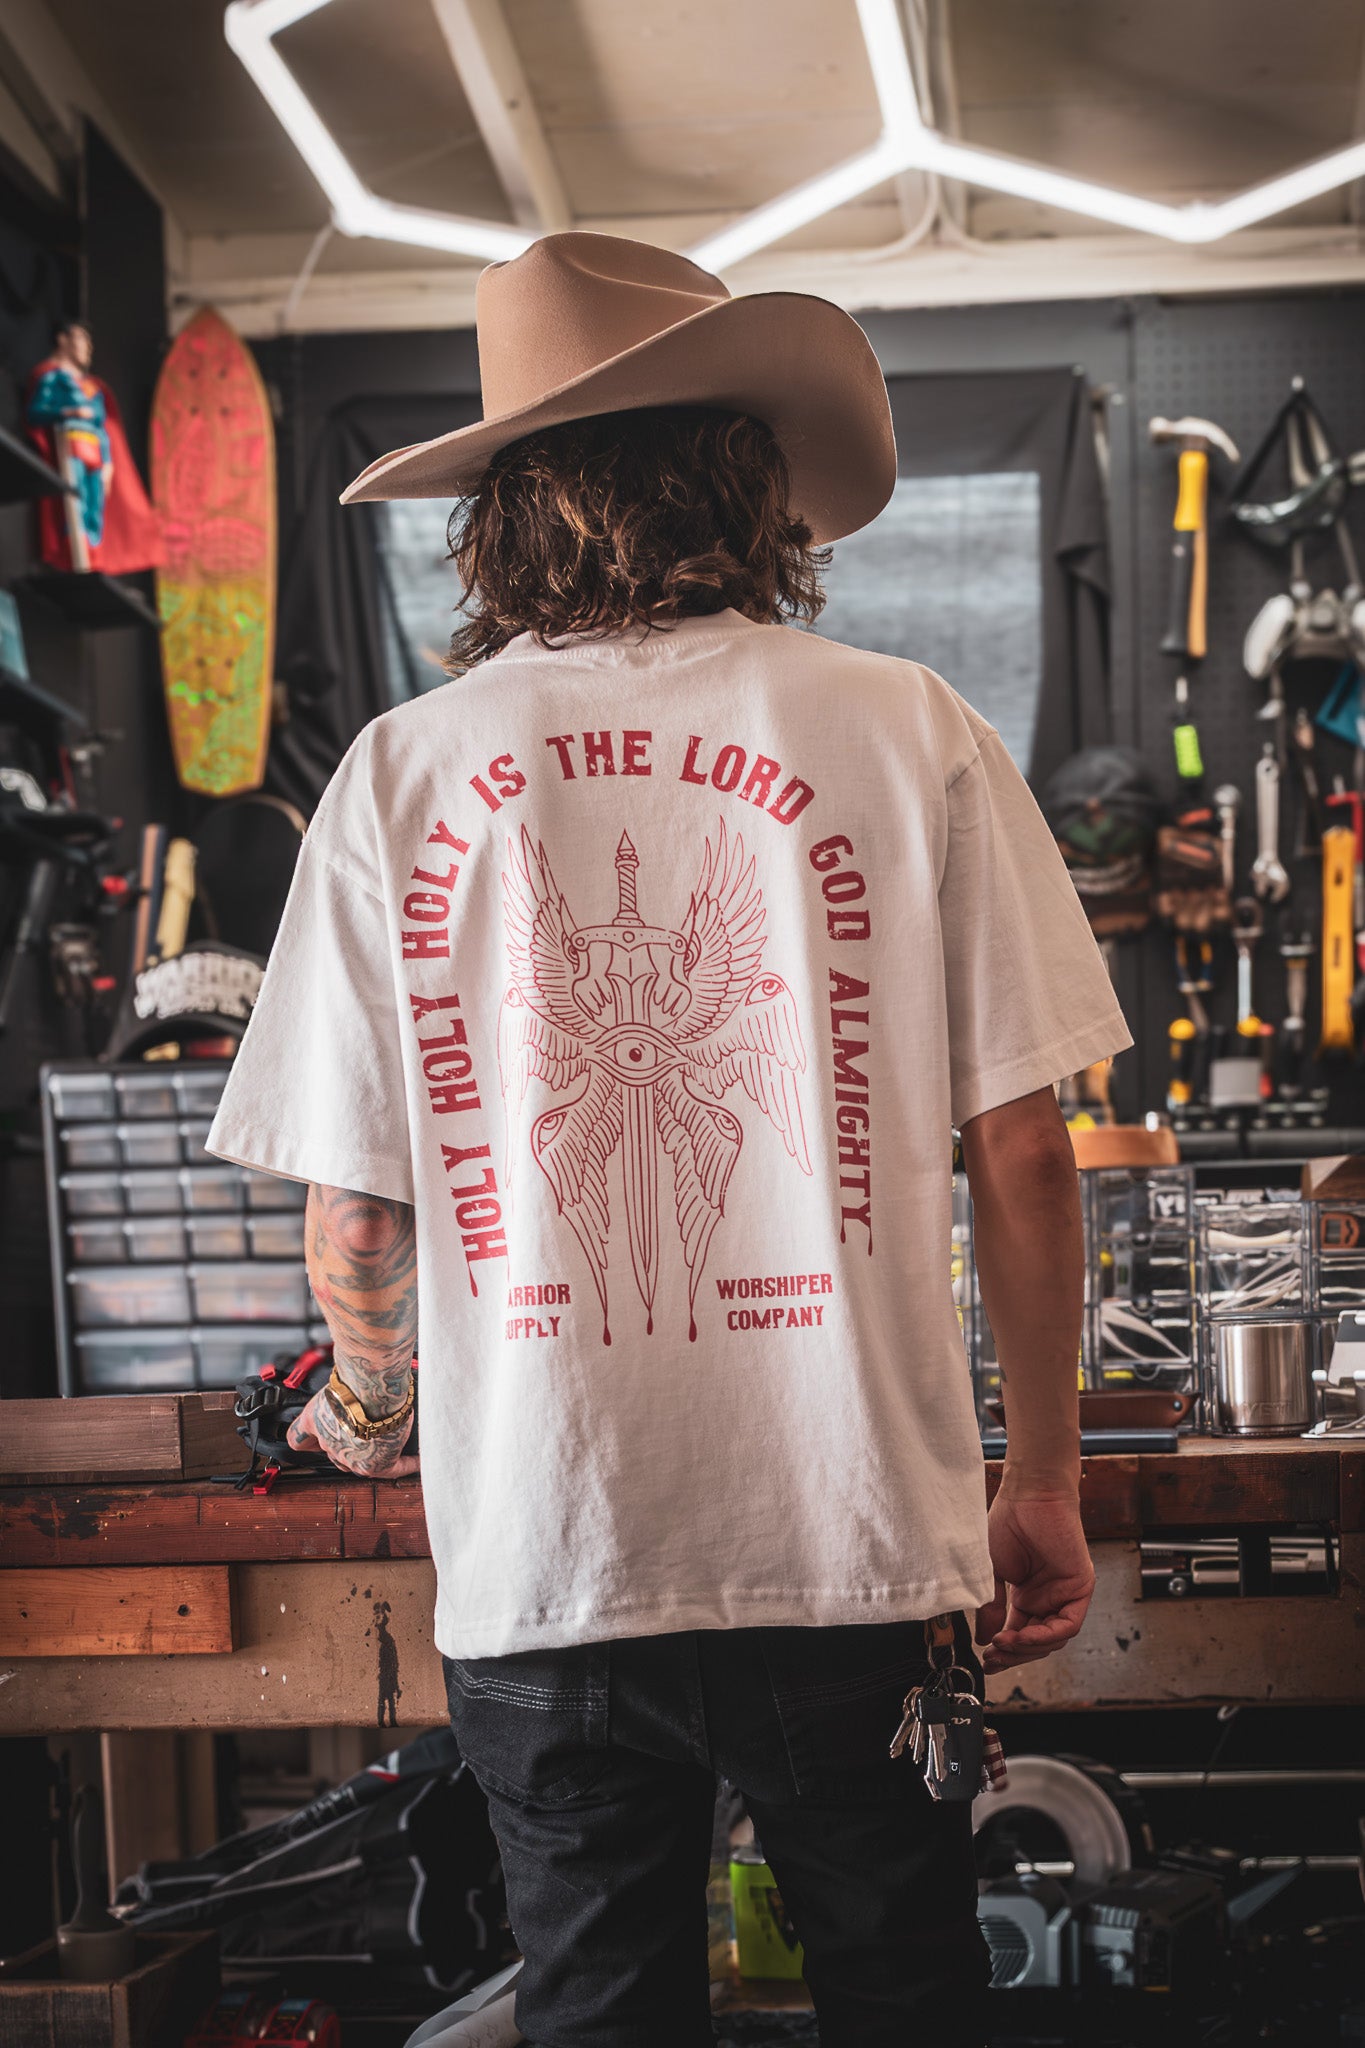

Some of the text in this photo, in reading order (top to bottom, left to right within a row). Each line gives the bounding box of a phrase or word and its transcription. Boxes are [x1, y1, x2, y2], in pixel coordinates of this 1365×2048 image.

[401, 730, 874, 1298] HOLY HOLY HOLY IS THE LORD GOD ALMIGHTY
[507, 1283, 571, 1308] ARRIOR
[716, 1273, 833, 1300] WORSHIPER
[505, 1316, 560, 1340] UPPLY
[727, 1305, 824, 1331] COMPANY
